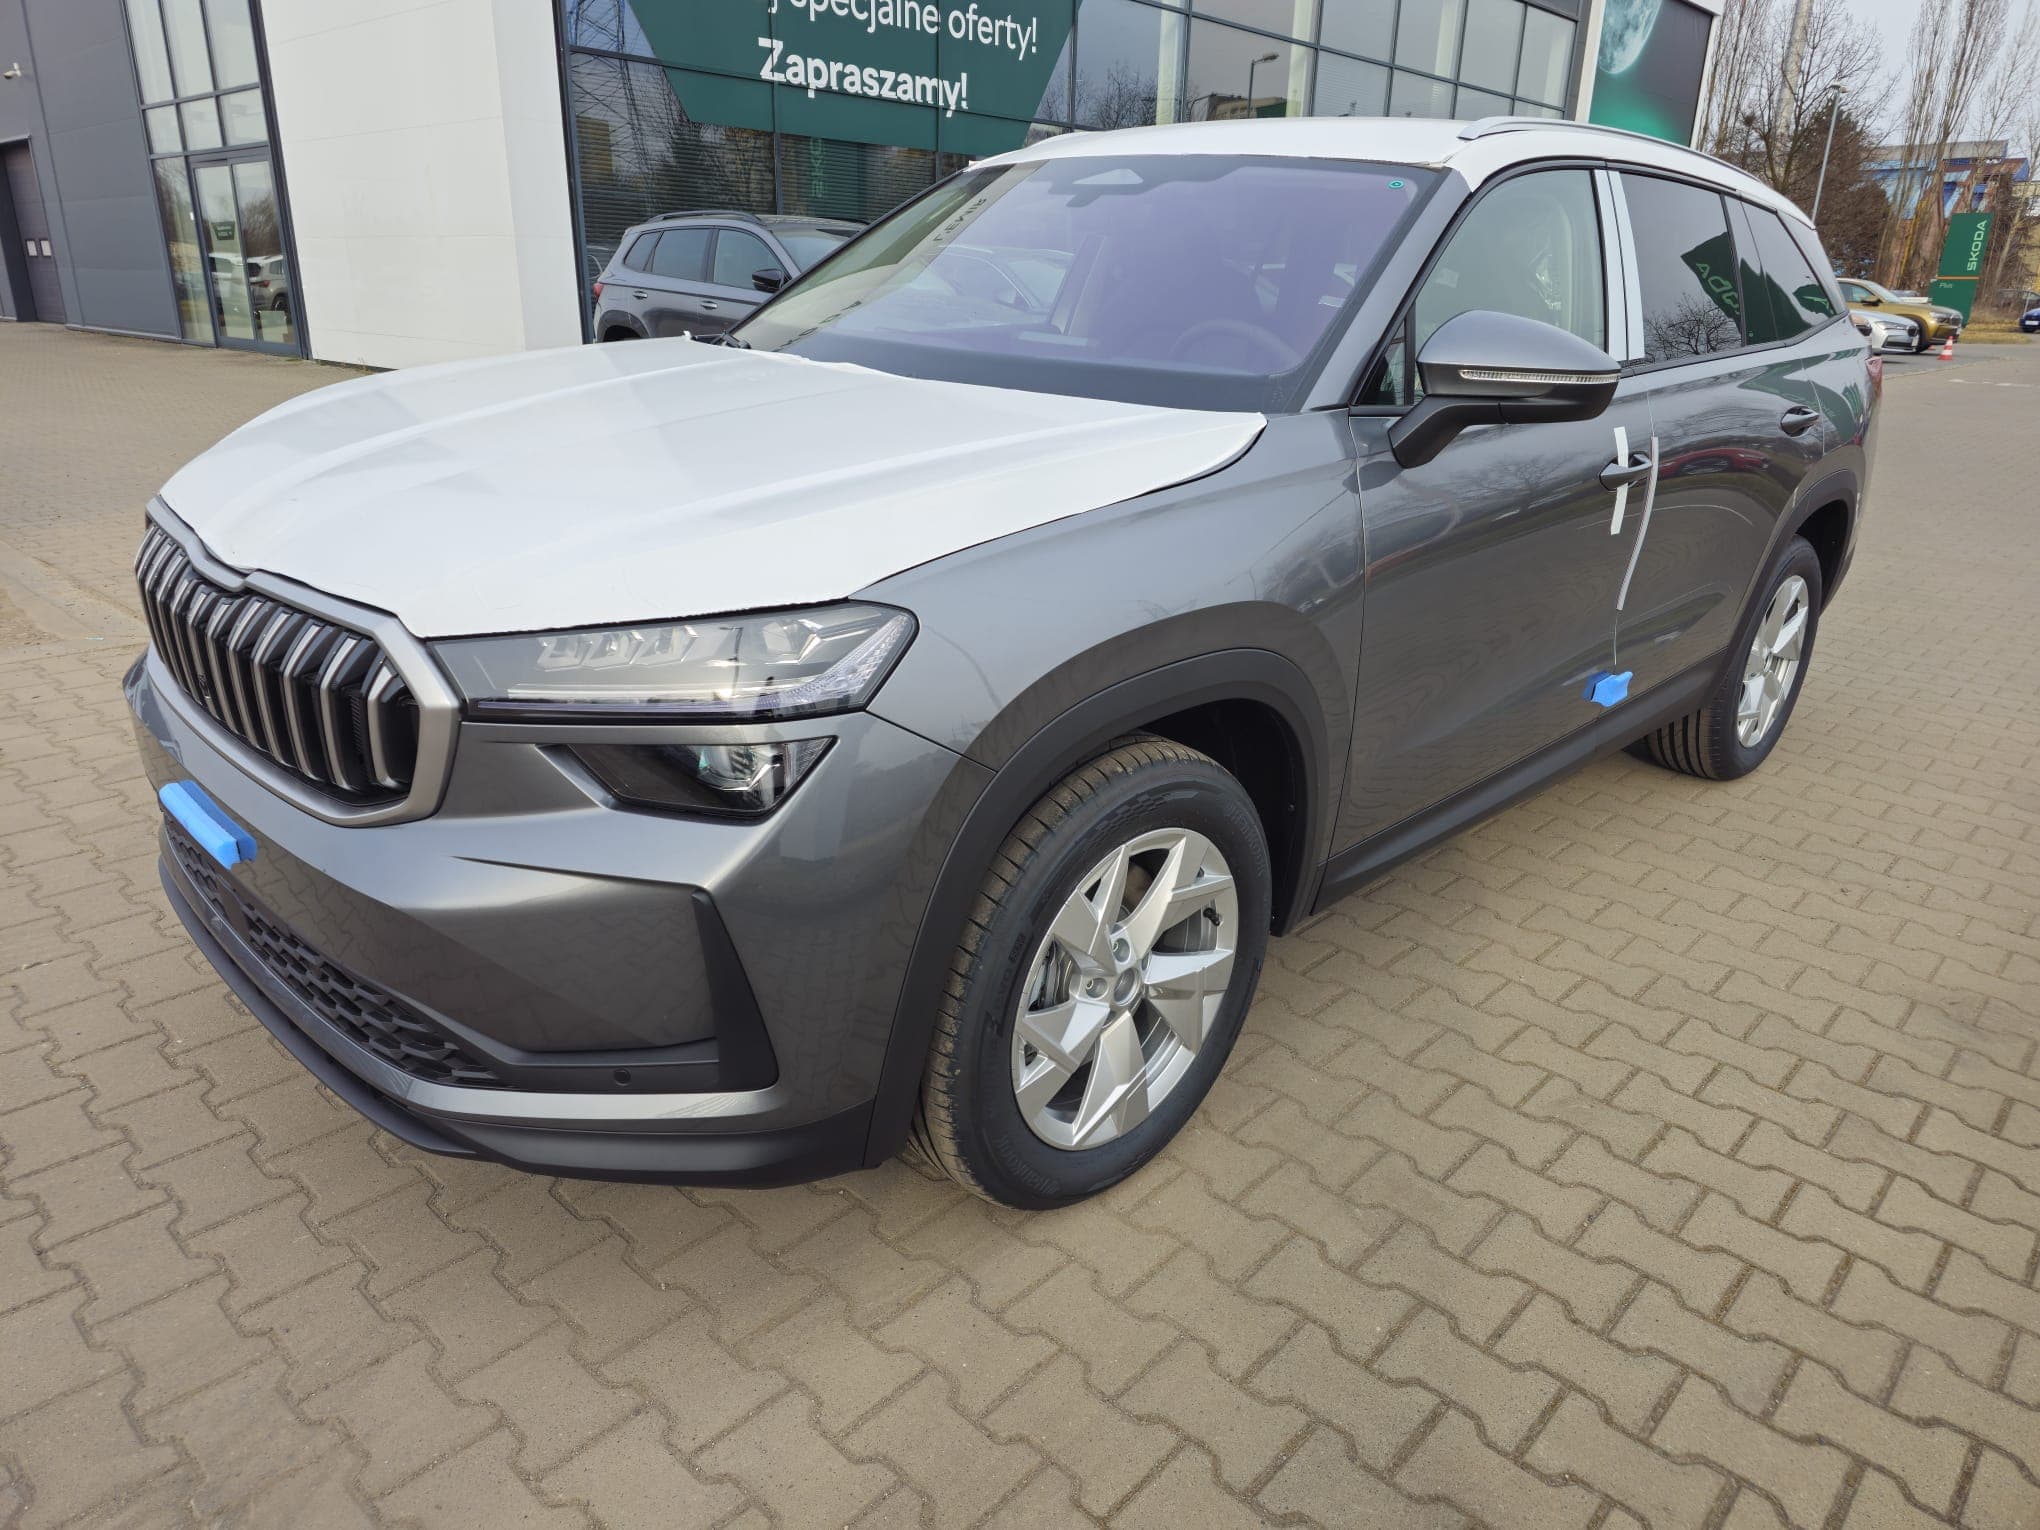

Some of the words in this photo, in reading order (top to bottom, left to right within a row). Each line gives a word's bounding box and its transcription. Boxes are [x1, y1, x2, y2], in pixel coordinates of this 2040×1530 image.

[789, 0, 940, 33] pecjalne
[948, 3, 1037, 61] oferty!
[758, 37, 968, 117] Zapraszamy!
